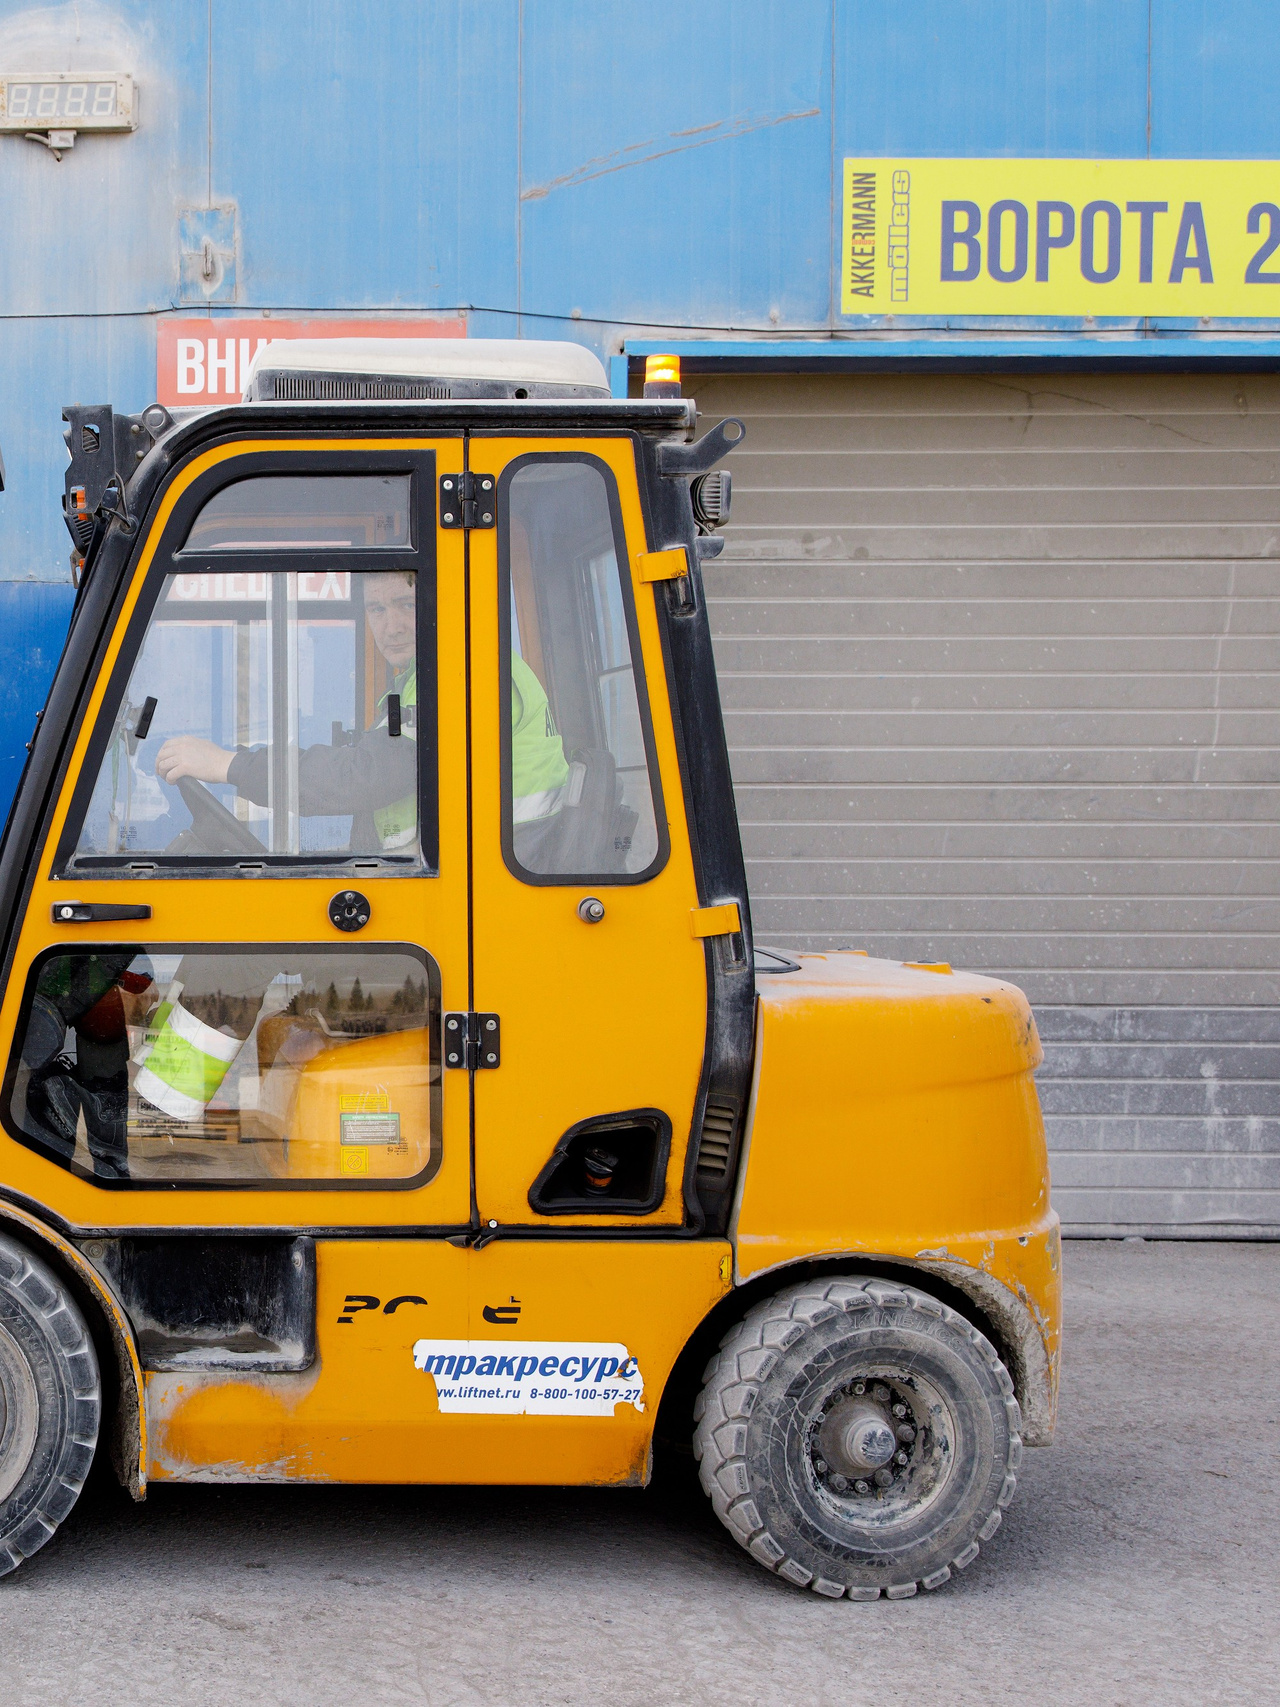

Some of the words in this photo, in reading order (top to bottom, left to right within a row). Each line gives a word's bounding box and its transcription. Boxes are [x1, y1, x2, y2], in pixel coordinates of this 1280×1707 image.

[850, 172, 876, 298] AKKERMANN
[940, 199, 1214, 284] ВОРОТА
[1244, 202, 1280, 284] 2
[530, 1388, 641, 1400] 8-800-100-57-27
